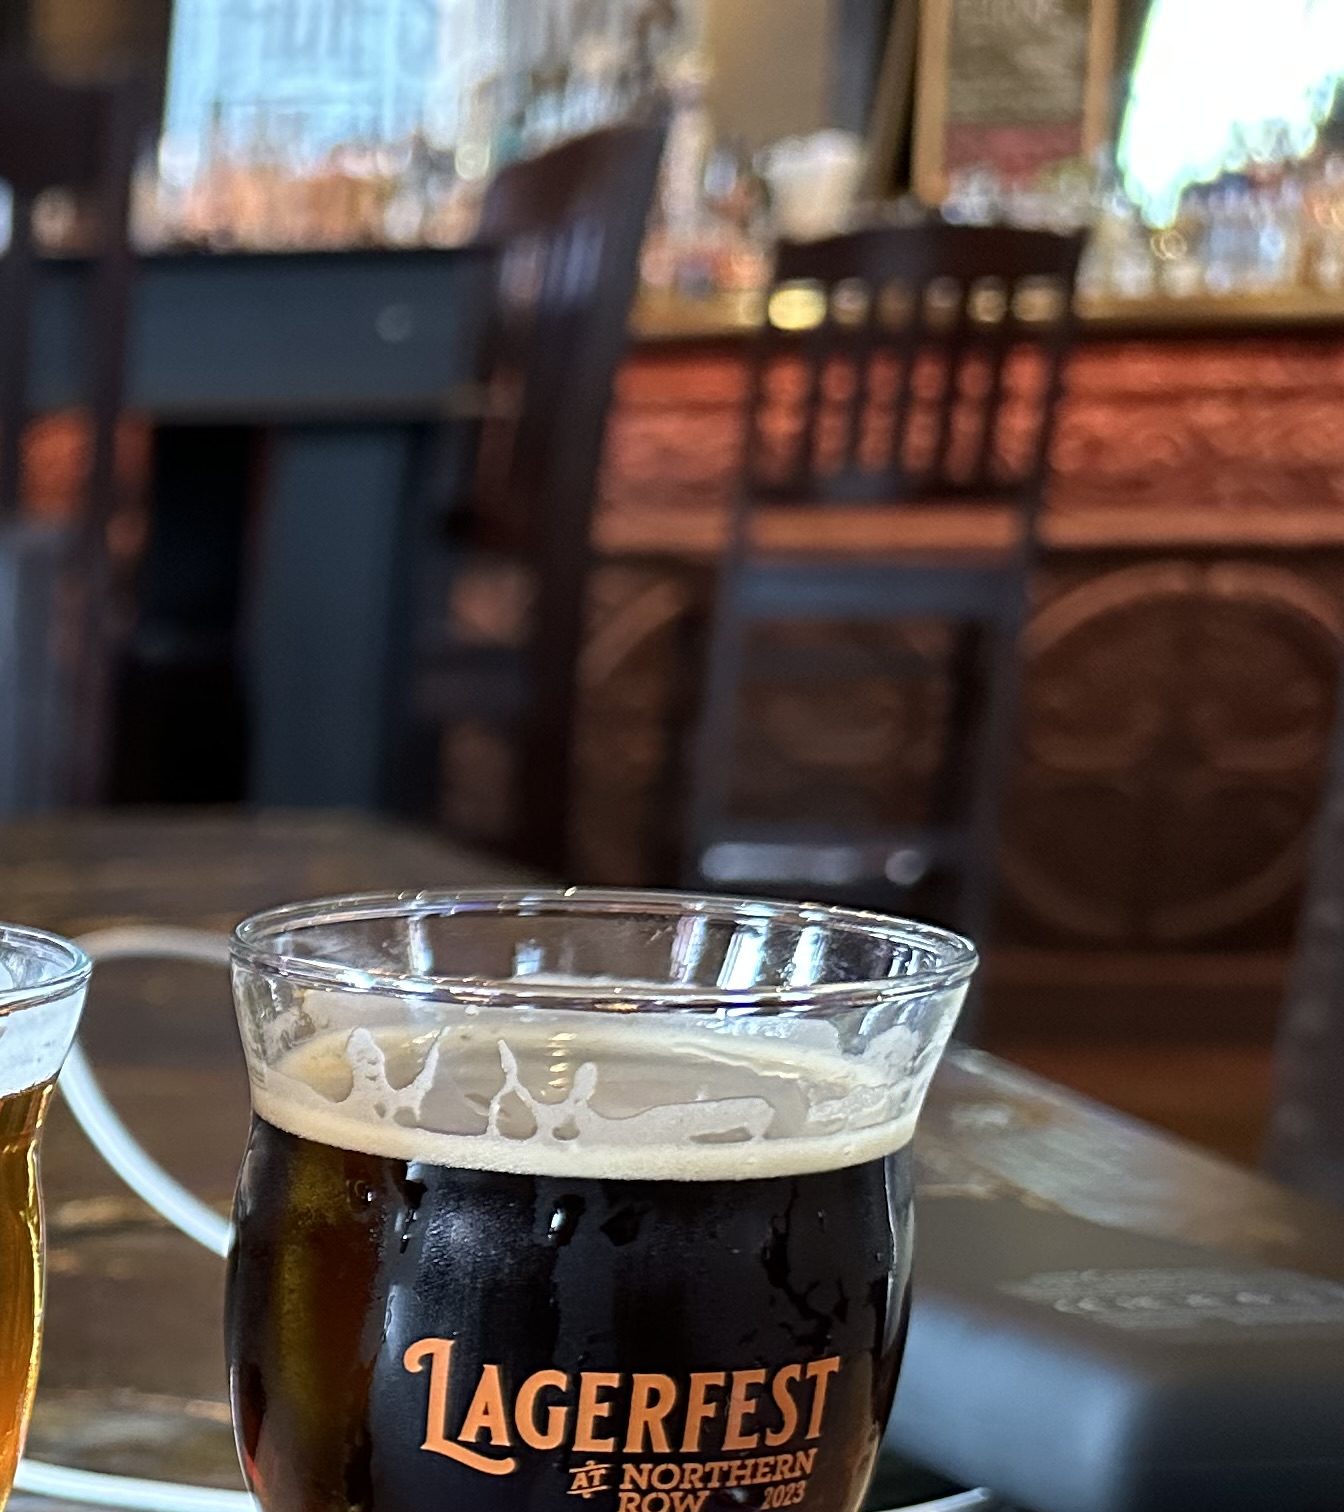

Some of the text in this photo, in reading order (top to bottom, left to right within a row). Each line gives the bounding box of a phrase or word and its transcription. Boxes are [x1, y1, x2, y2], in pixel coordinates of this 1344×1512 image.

[403, 1337, 841, 1475] LAGERFEST
[622, 1447, 818, 1492] NORTHERN
[760, 1480, 806, 1511] 2023
